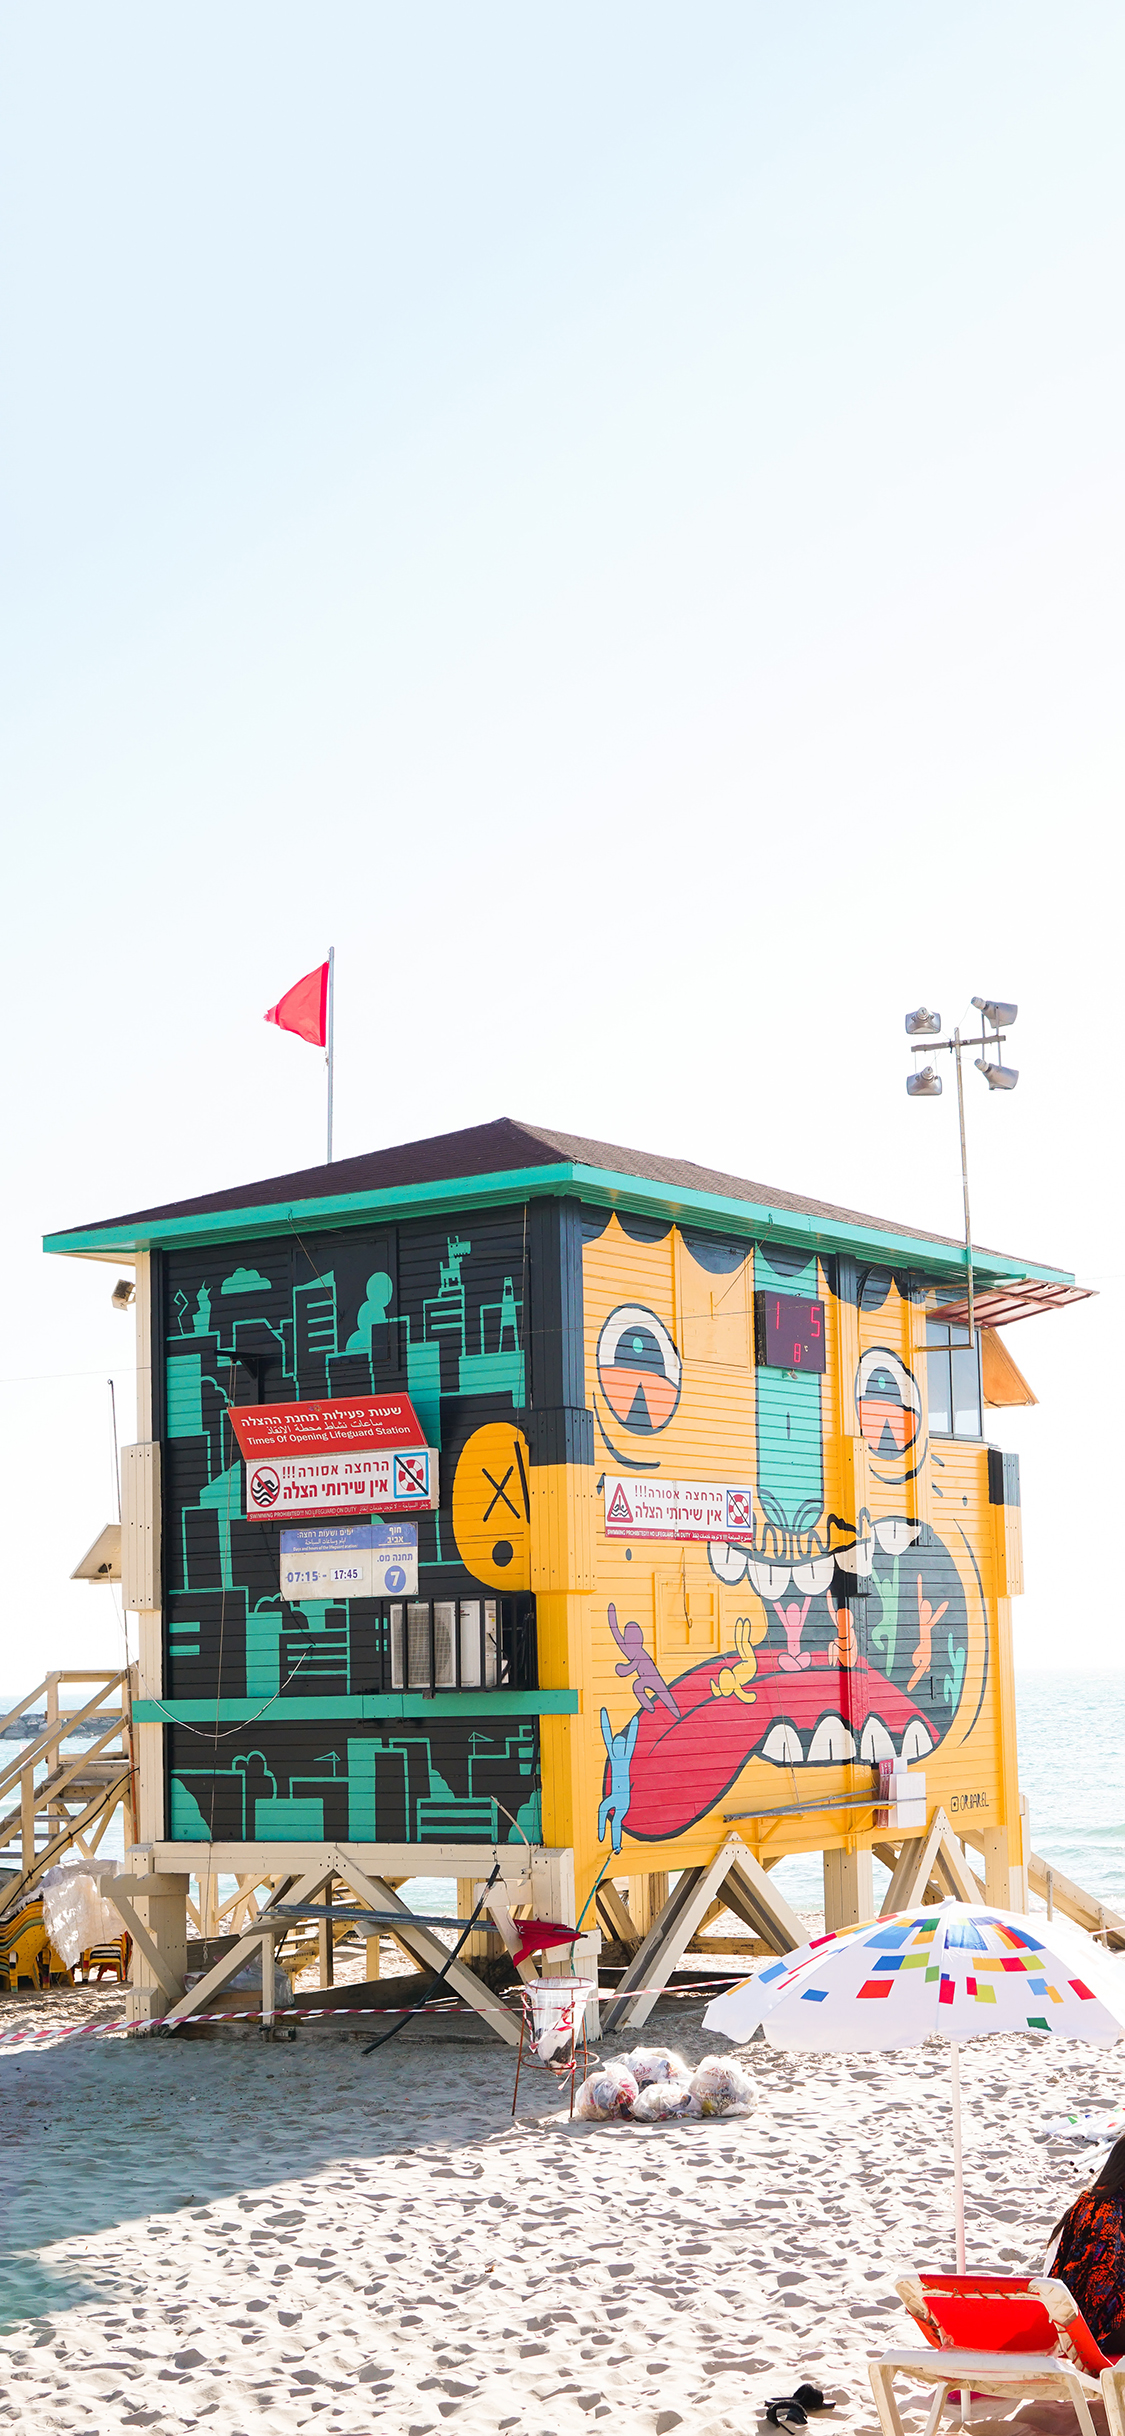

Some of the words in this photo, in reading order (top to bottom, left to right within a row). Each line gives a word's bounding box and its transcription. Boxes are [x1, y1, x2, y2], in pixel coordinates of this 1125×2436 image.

[810, 1307, 821, 1337] 5
[793, 1343, 801, 1363] 8
[322, 1409, 365, 1421] פעילות
[369, 1406, 402, 1417] שעות
[241, 1416, 282, 1427] ההצלה
[285, 1414, 319, 1424] תחנת
[351, 1420, 383, 1428] ساعات
[294, 1424, 322, 1432] محطة
[325, 1422, 347, 1430] نشاط
[247, 1436, 275, 1446] Times
[277, 1435, 287, 1443] Of
[289, 1432, 328, 1443] Opening
[330, 1428, 374, 1440] Lifeguard
[376, 1425, 410, 1435] Station
[345, 1460, 389, 1474] הרחצה
[283, 1482, 317, 1500] הצלה
[322, 1481, 365, 1496] שירותי
[370, 1479, 388, 1498] אין
[685, 1490, 723, 1502] הרחצה
[635, 1502, 663, 1519] הצלה
[666, 1506, 703, 1521] שירותי
[707, 1509, 722, 1525] אין
[389, 1527, 401, 1535] חוף
[393, 1553, 413, 1561] תחנה
[334, 1569, 358, 1579] 17:45
[390, 1571, 400, 1586] 7
